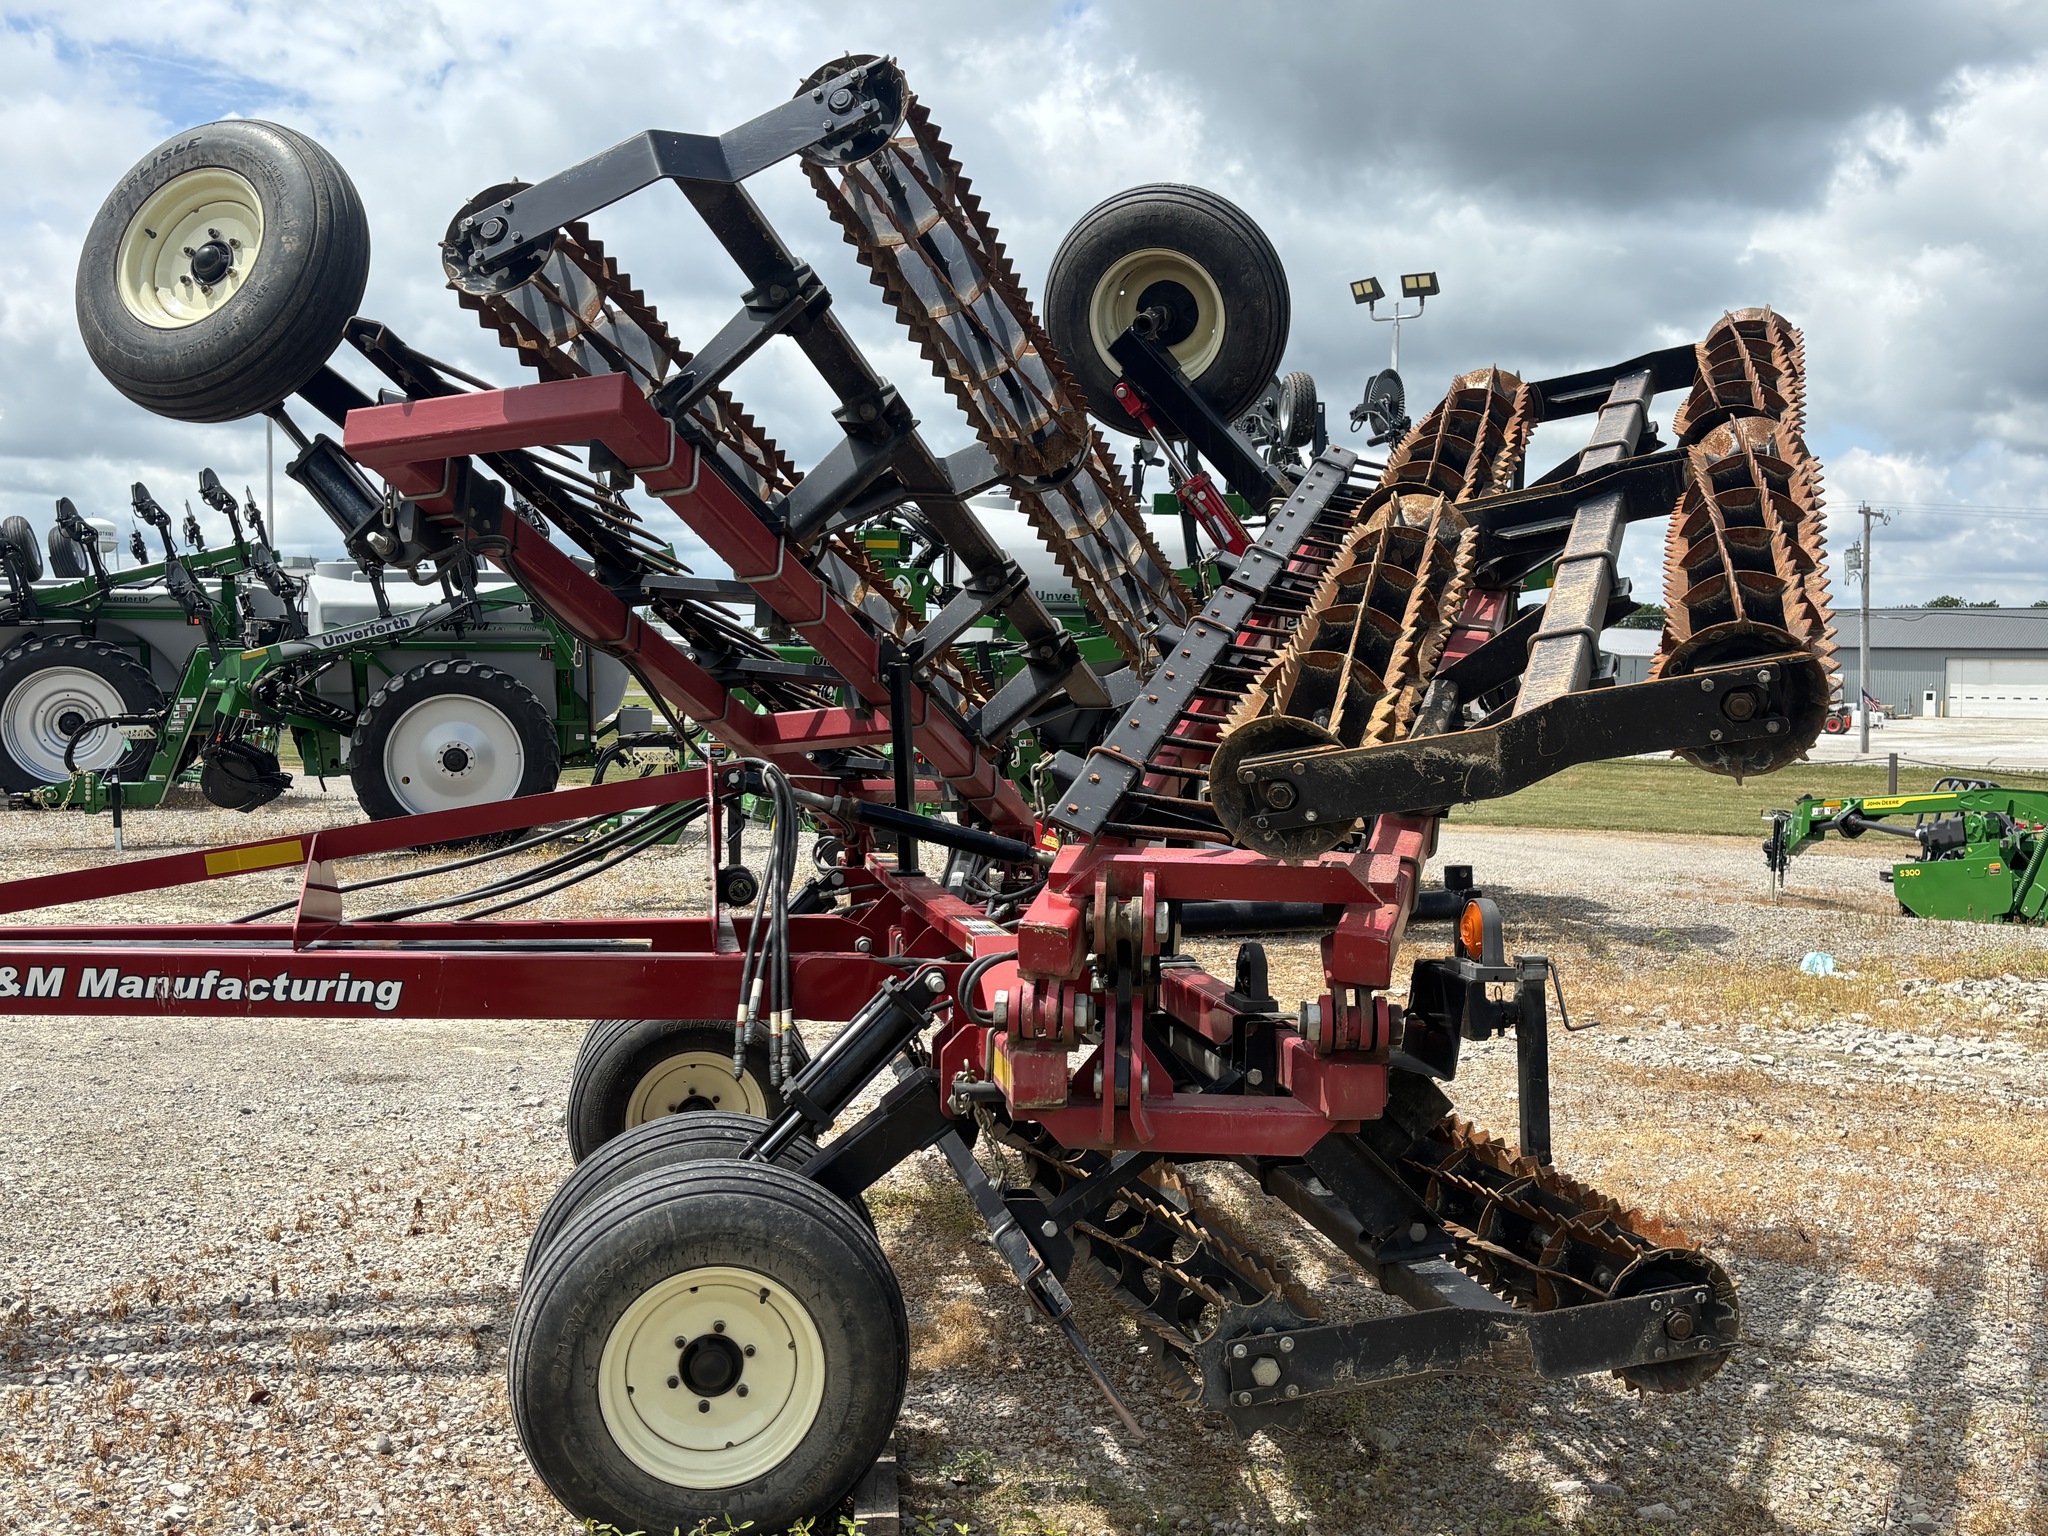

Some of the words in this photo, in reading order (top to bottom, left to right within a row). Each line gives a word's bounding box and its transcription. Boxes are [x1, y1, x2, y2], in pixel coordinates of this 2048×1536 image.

[105, 136, 203, 218] CARLISLE
[181, 315, 241, 357] SPECIALIST
[321, 616, 411, 647] Unverferth
[1899, 868, 1921, 877] S300
[77, 966, 404, 1011] Manufacturing
[551, 1239, 652, 1390] CARLISLE
[786, 1433, 852, 1507] SPECIALIST
